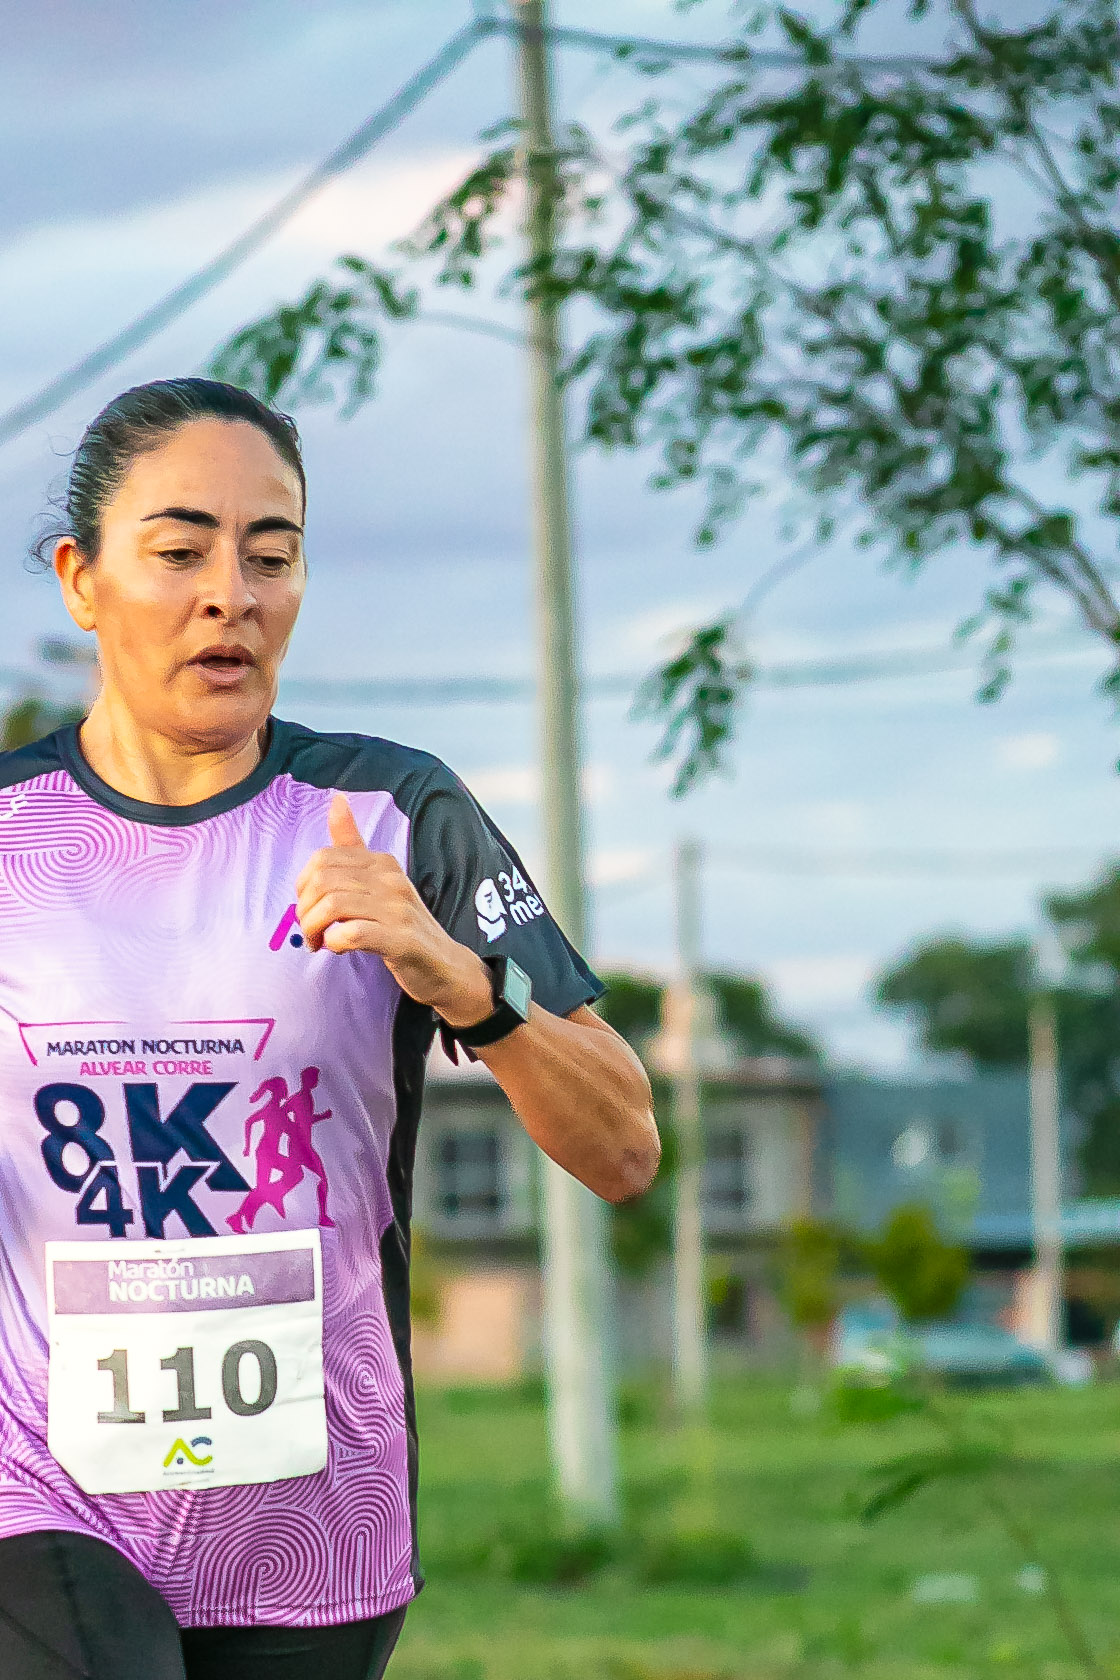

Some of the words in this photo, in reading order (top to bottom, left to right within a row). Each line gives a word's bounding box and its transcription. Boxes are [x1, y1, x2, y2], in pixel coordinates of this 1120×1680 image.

[47, 1039, 135, 1056] MARATON
[142, 1038, 245, 1055] NOCTURNA
[80, 1060, 147, 1076] ALVEAR
[153, 1060, 213, 1075] CORRE
[34, 1081, 252, 1193] 8K
[76, 1165, 219, 1240] 4K
[108, 1257, 195, 1279] Maratón
[108, 1274, 256, 1302] NOCTURNA
[97, 1339, 278, 1424] 110
